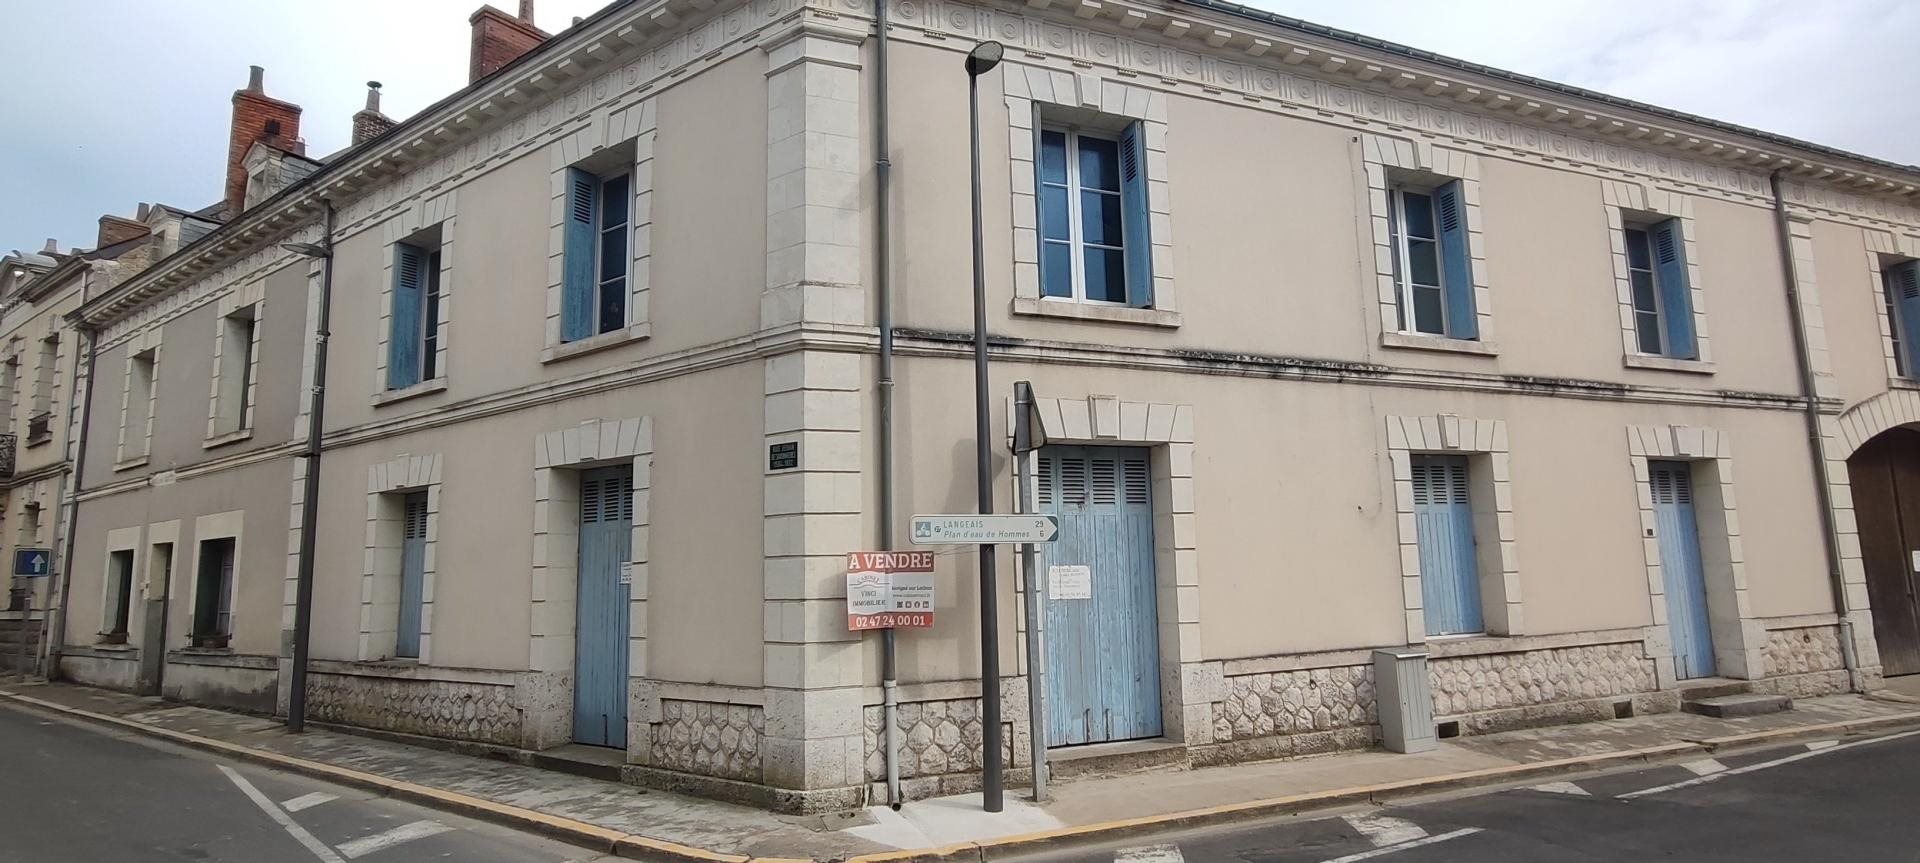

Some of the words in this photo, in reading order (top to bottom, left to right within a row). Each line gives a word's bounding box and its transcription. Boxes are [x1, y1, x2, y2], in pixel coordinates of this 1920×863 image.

[943, 520, 984, 528] LANGEAIS
[1034, 520, 1044, 528] 29
[943, 530, 961, 538] Plan
[963, 530, 984, 538] d'eau
[986, 530, 996, 538] de
[999, 530, 1030, 538] Hommes
[849, 553, 861, 570] A
[863, 552, 933, 570] VENDRE
[852, 599, 887, 607] IMMOBILIER
[855, 616, 868, 628] 02
[869, 615, 881, 627] 47
[882, 615, 895, 626] 24
[897, 615, 911, 626] 00
[912, 615, 926, 626] 01
